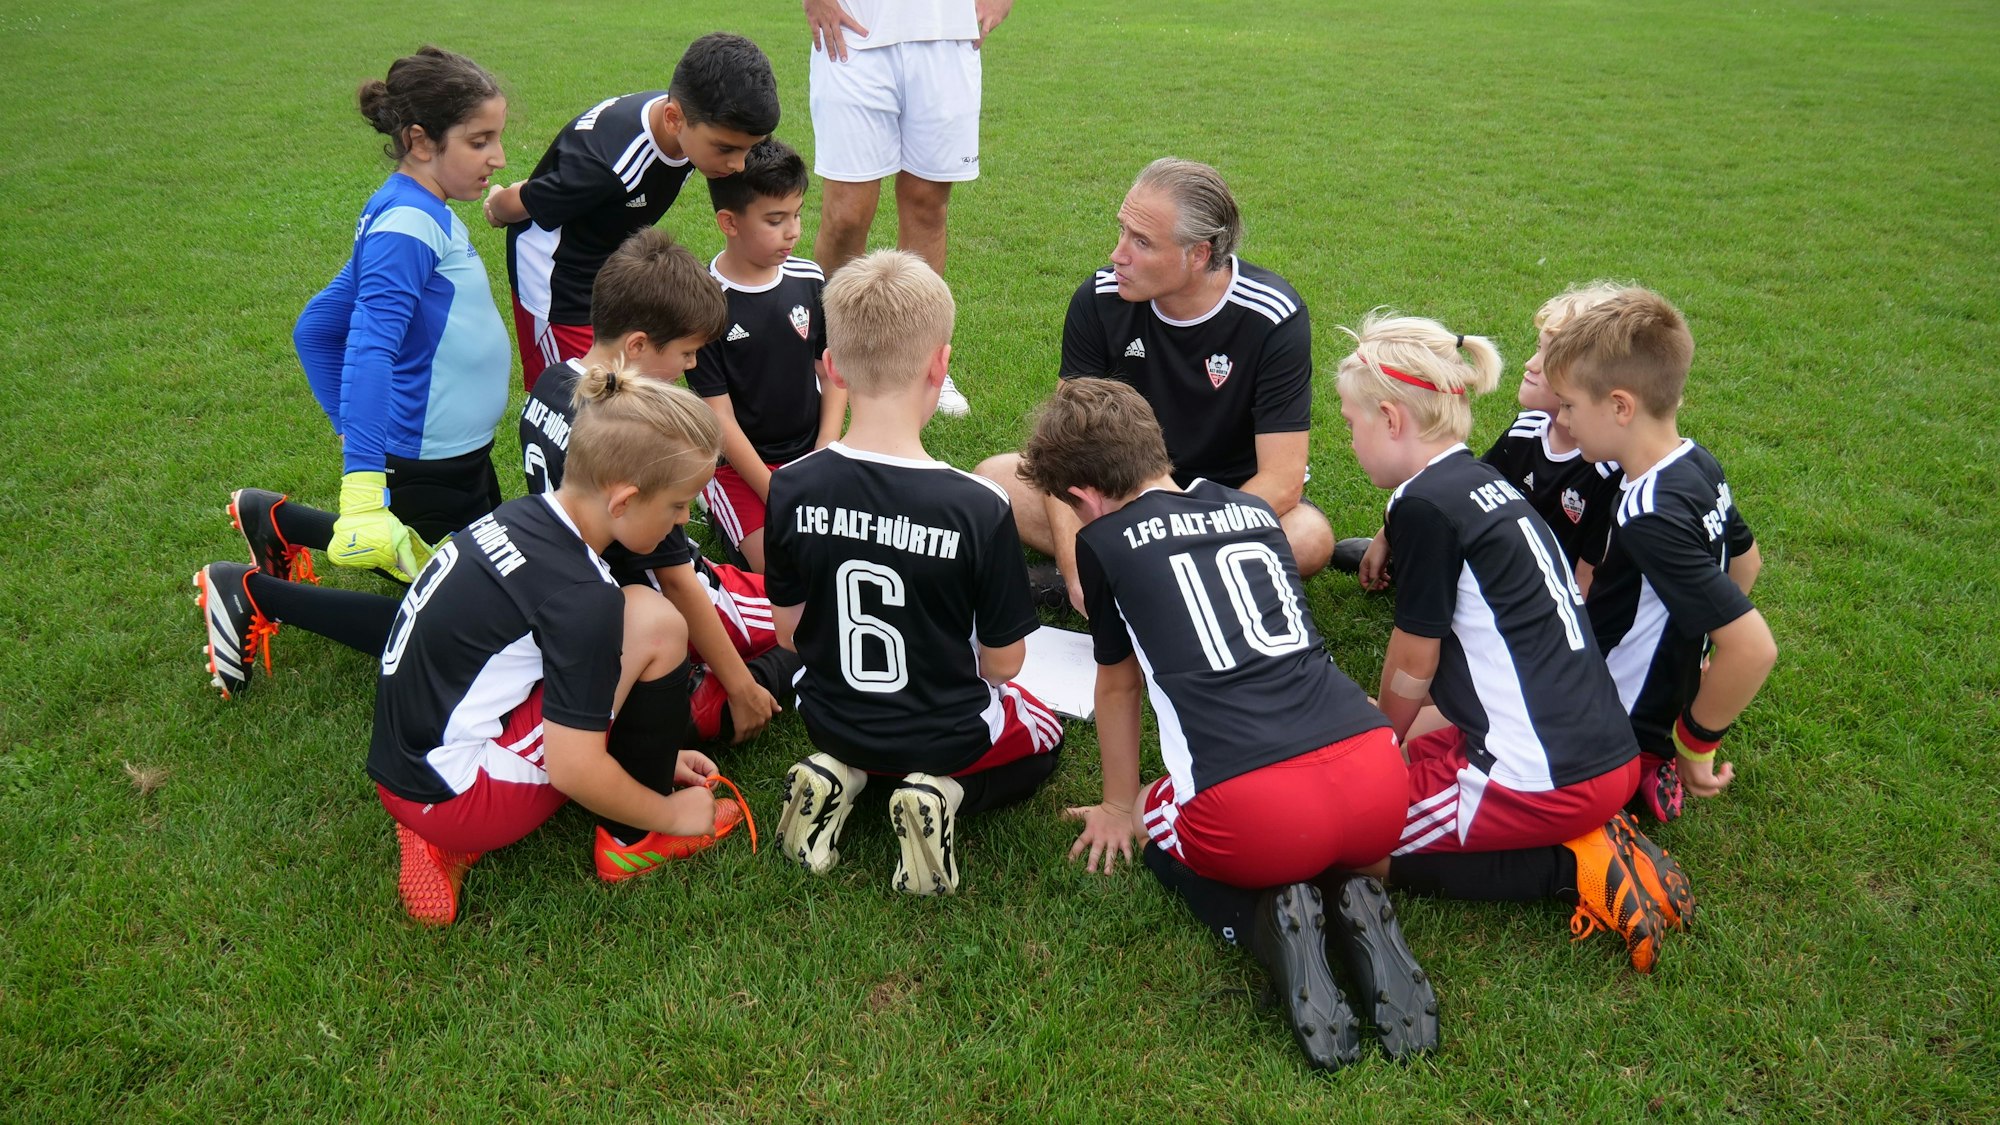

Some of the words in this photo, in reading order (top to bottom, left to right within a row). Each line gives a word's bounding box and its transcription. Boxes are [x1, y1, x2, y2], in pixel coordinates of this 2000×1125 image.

[1469, 482, 1508, 513] 1.FC
[796, 505, 829, 535] 1.FC
[832, 507, 961, 560] ALT-HÜRTH
[1123, 517, 1167, 550] 1.FC
[836, 559, 909, 693] 6
[1169, 542, 1310, 672] 10
